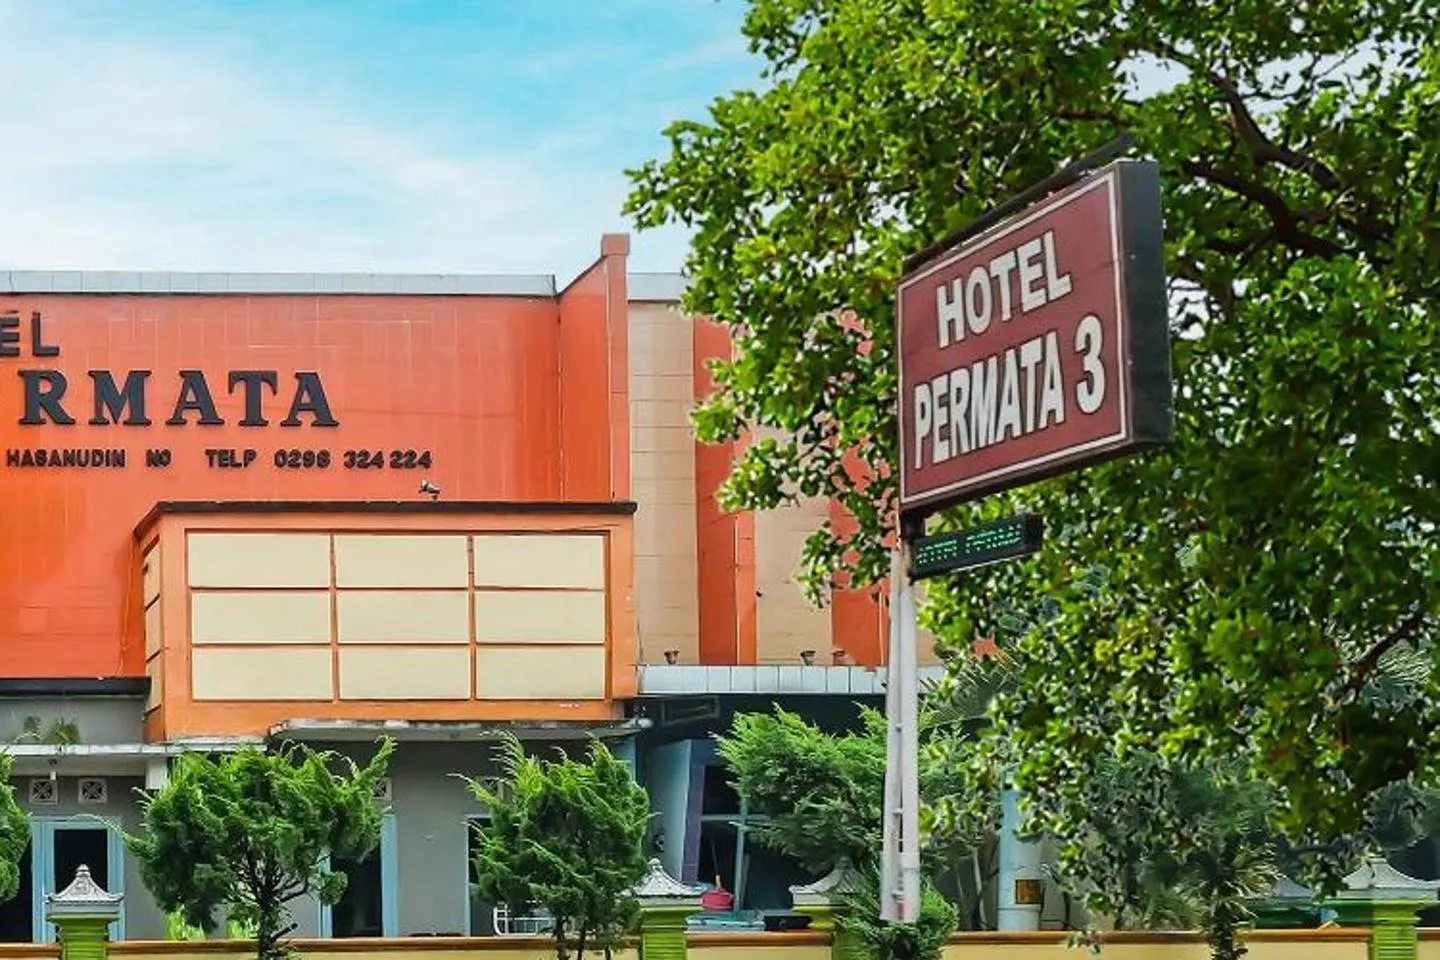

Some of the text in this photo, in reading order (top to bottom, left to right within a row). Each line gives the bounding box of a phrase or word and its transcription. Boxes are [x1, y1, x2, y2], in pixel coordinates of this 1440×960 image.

[936, 230, 1072, 349] HOTEL
[913, 314, 1106, 470] PERMATA 3
[7, 449, 126, 468] HASANUDIN
[205, 449, 257, 468] TELP
[343, 450, 385, 469] 324
[389, 449, 432, 469] 224
